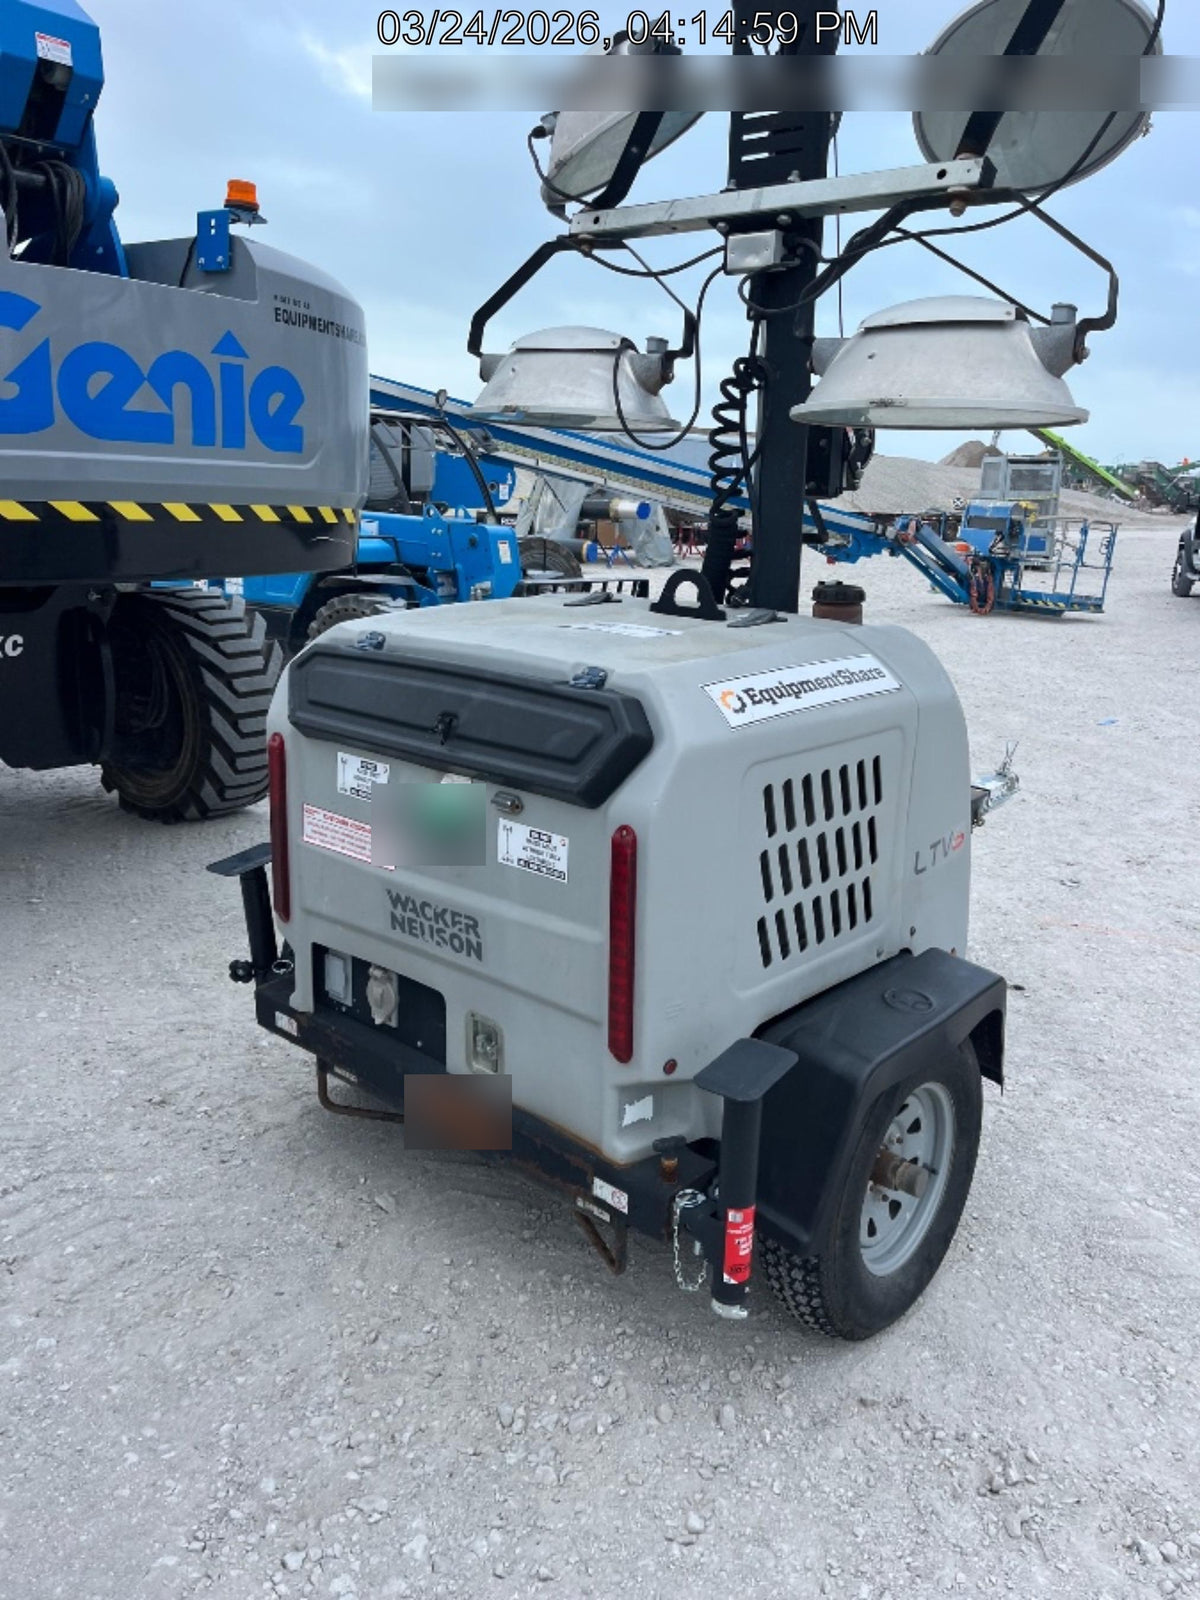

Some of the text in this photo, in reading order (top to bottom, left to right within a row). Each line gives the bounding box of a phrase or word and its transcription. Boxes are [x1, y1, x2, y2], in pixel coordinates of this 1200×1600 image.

[742, 667, 886, 706] EquipmentShare
[386, 889, 480, 939] WACKER
[391, 911, 483, 961] NEUSON
